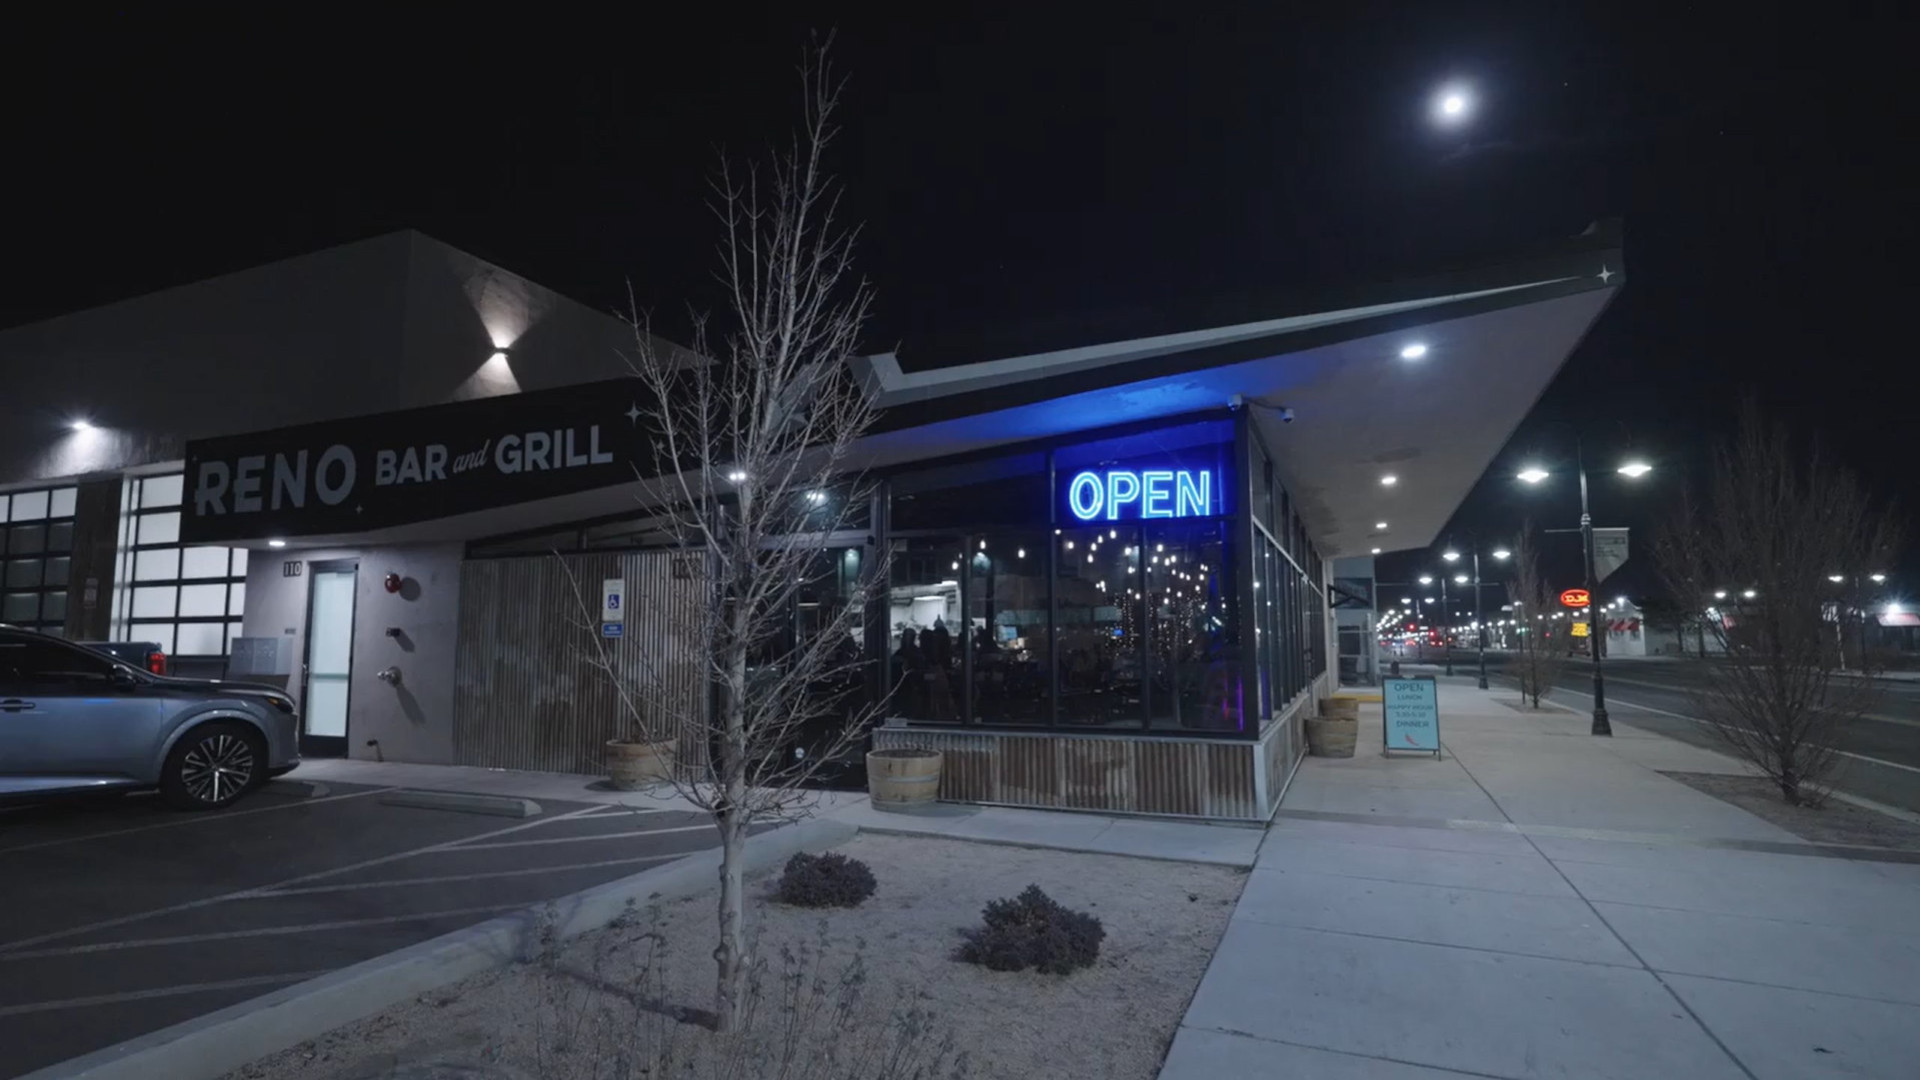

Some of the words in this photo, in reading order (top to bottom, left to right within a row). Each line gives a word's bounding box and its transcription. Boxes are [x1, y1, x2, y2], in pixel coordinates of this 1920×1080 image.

[195, 444, 356, 516] RENO
[375, 444, 448, 486] BAR
[452, 439, 491, 474] and
[494, 425, 613, 474] GRILL
[1069, 470, 1210, 520] OPEN
[284, 561, 302, 577] 110
[1394, 683, 1424, 692] OPEN
